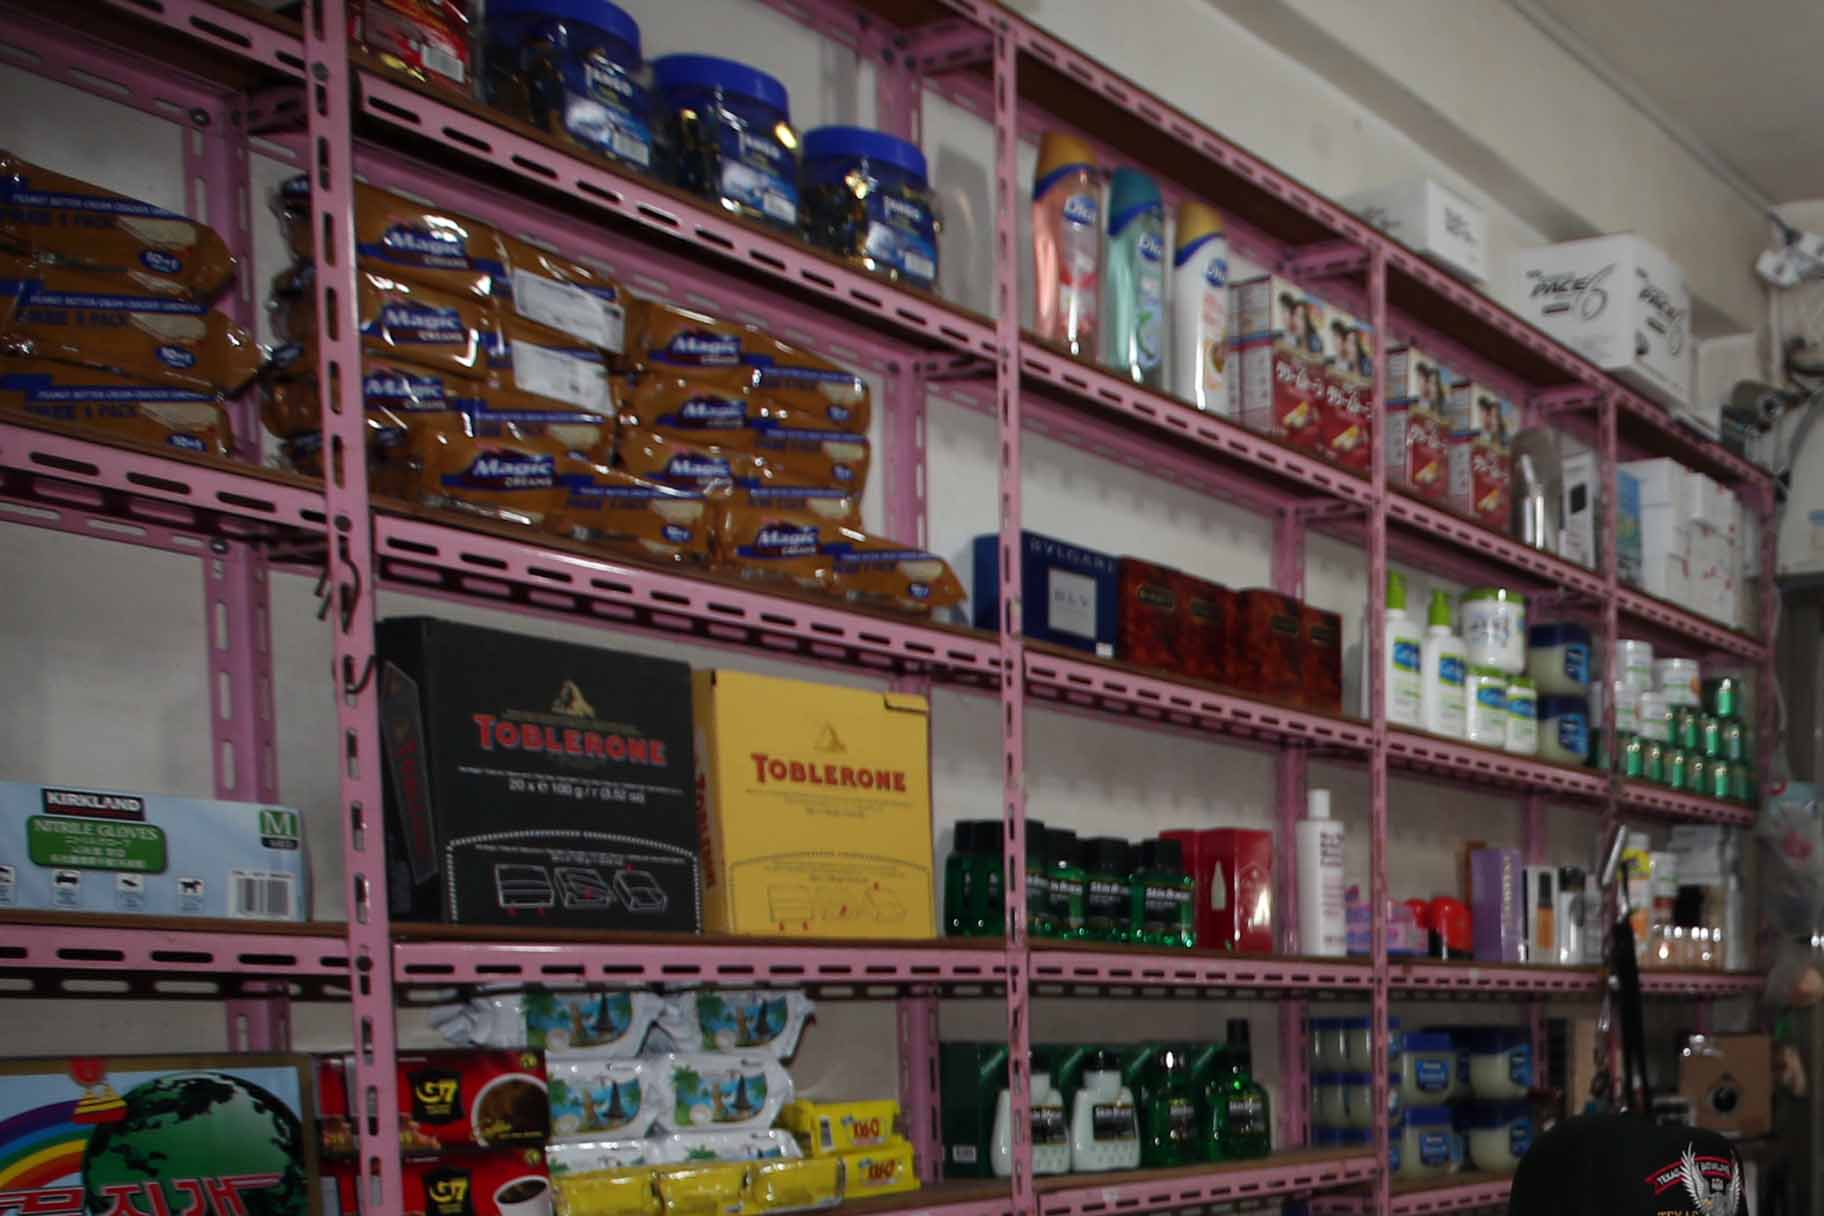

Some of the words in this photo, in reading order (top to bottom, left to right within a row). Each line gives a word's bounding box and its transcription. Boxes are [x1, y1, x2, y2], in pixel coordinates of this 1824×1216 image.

[391, 231, 460, 254] Magic
[385, 309, 458, 332] Magic
[672, 335, 737, 354] Magic
[365, 377, 442, 397] Magic
[682, 398, 743, 418] Magic
[473, 458, 553, 480] Magic
[668, 458, 732, 477] Magic
[757, 528, 818, 548] Magic
[472, 712, 668, 767] TOBLERONE
[750, 753, 907, 792] TOBLERONE
[46, 790, 141, 812] KIRKLAND
[33, 819, 95, 835] NITRILE
[97, 823, 159, 841] GLOVES
[263, 812, 293, 836] M
[414, 1076, 458, 1104] G7
[428, 1175, 472, 1203] G7
